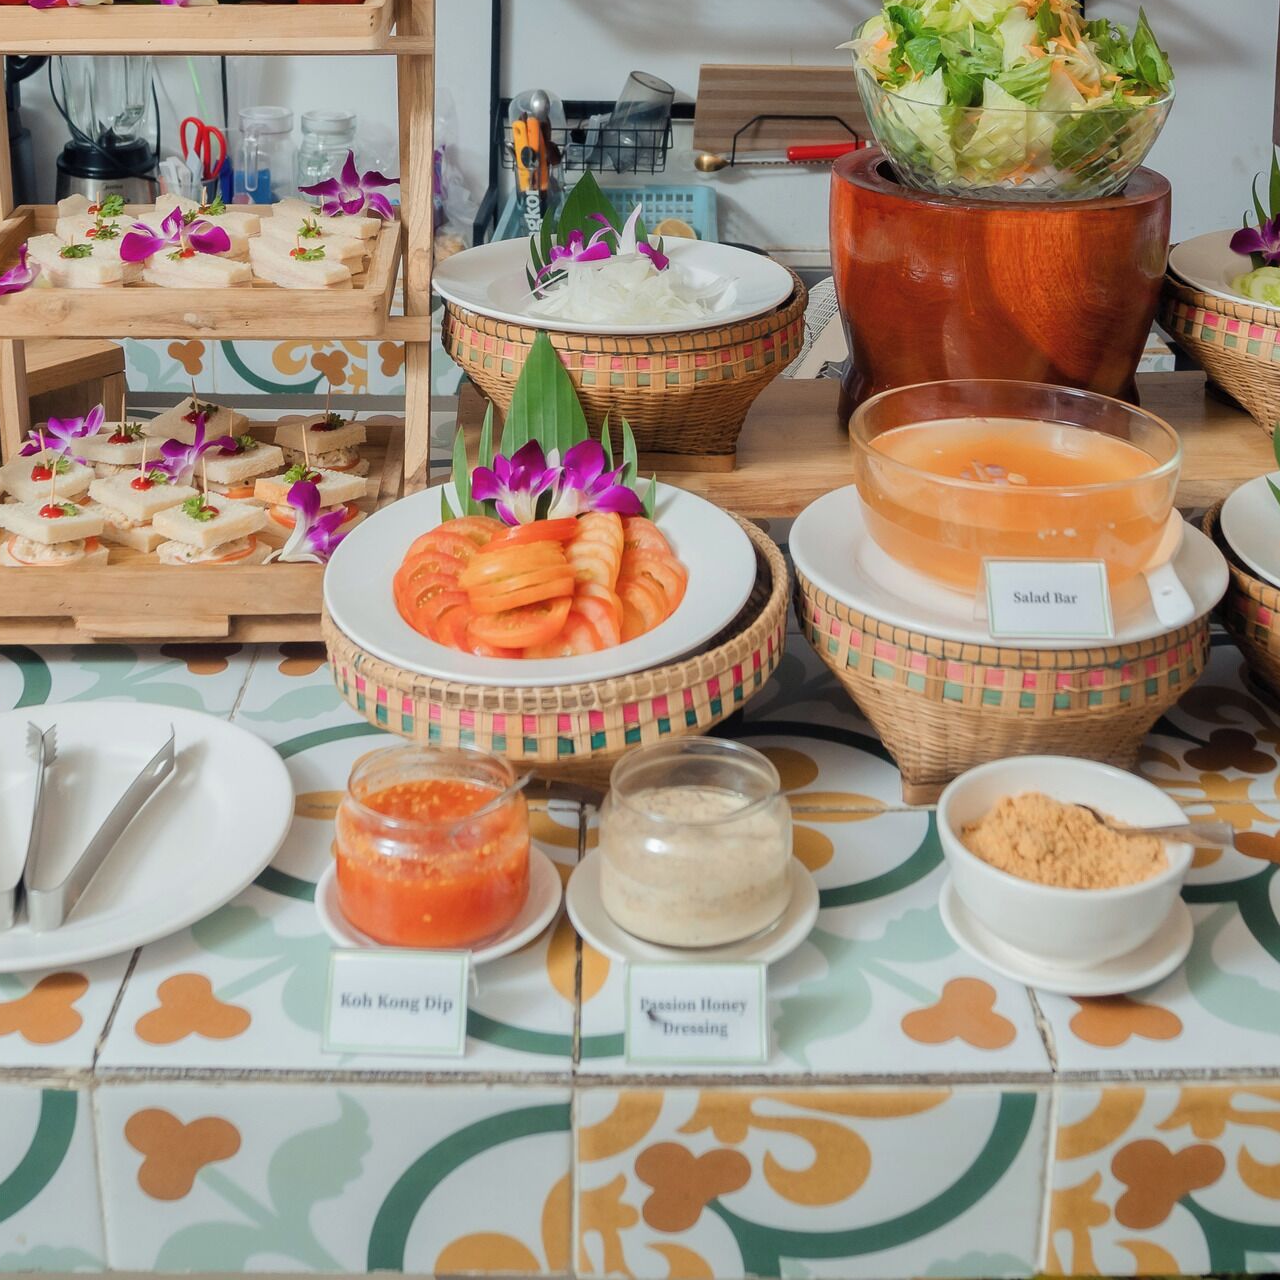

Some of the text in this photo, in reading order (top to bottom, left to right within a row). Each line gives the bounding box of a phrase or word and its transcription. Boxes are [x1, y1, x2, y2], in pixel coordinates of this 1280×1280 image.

[524, 187, 543, 234] gkor
[1013, 591, 1078, 604] Salad Bar
[340, 991, 454, 1015] Koh Kong Dip
[640, 996, 747, 1016] Passion Honey
[662, 1019, 729, 1038] Dressing
